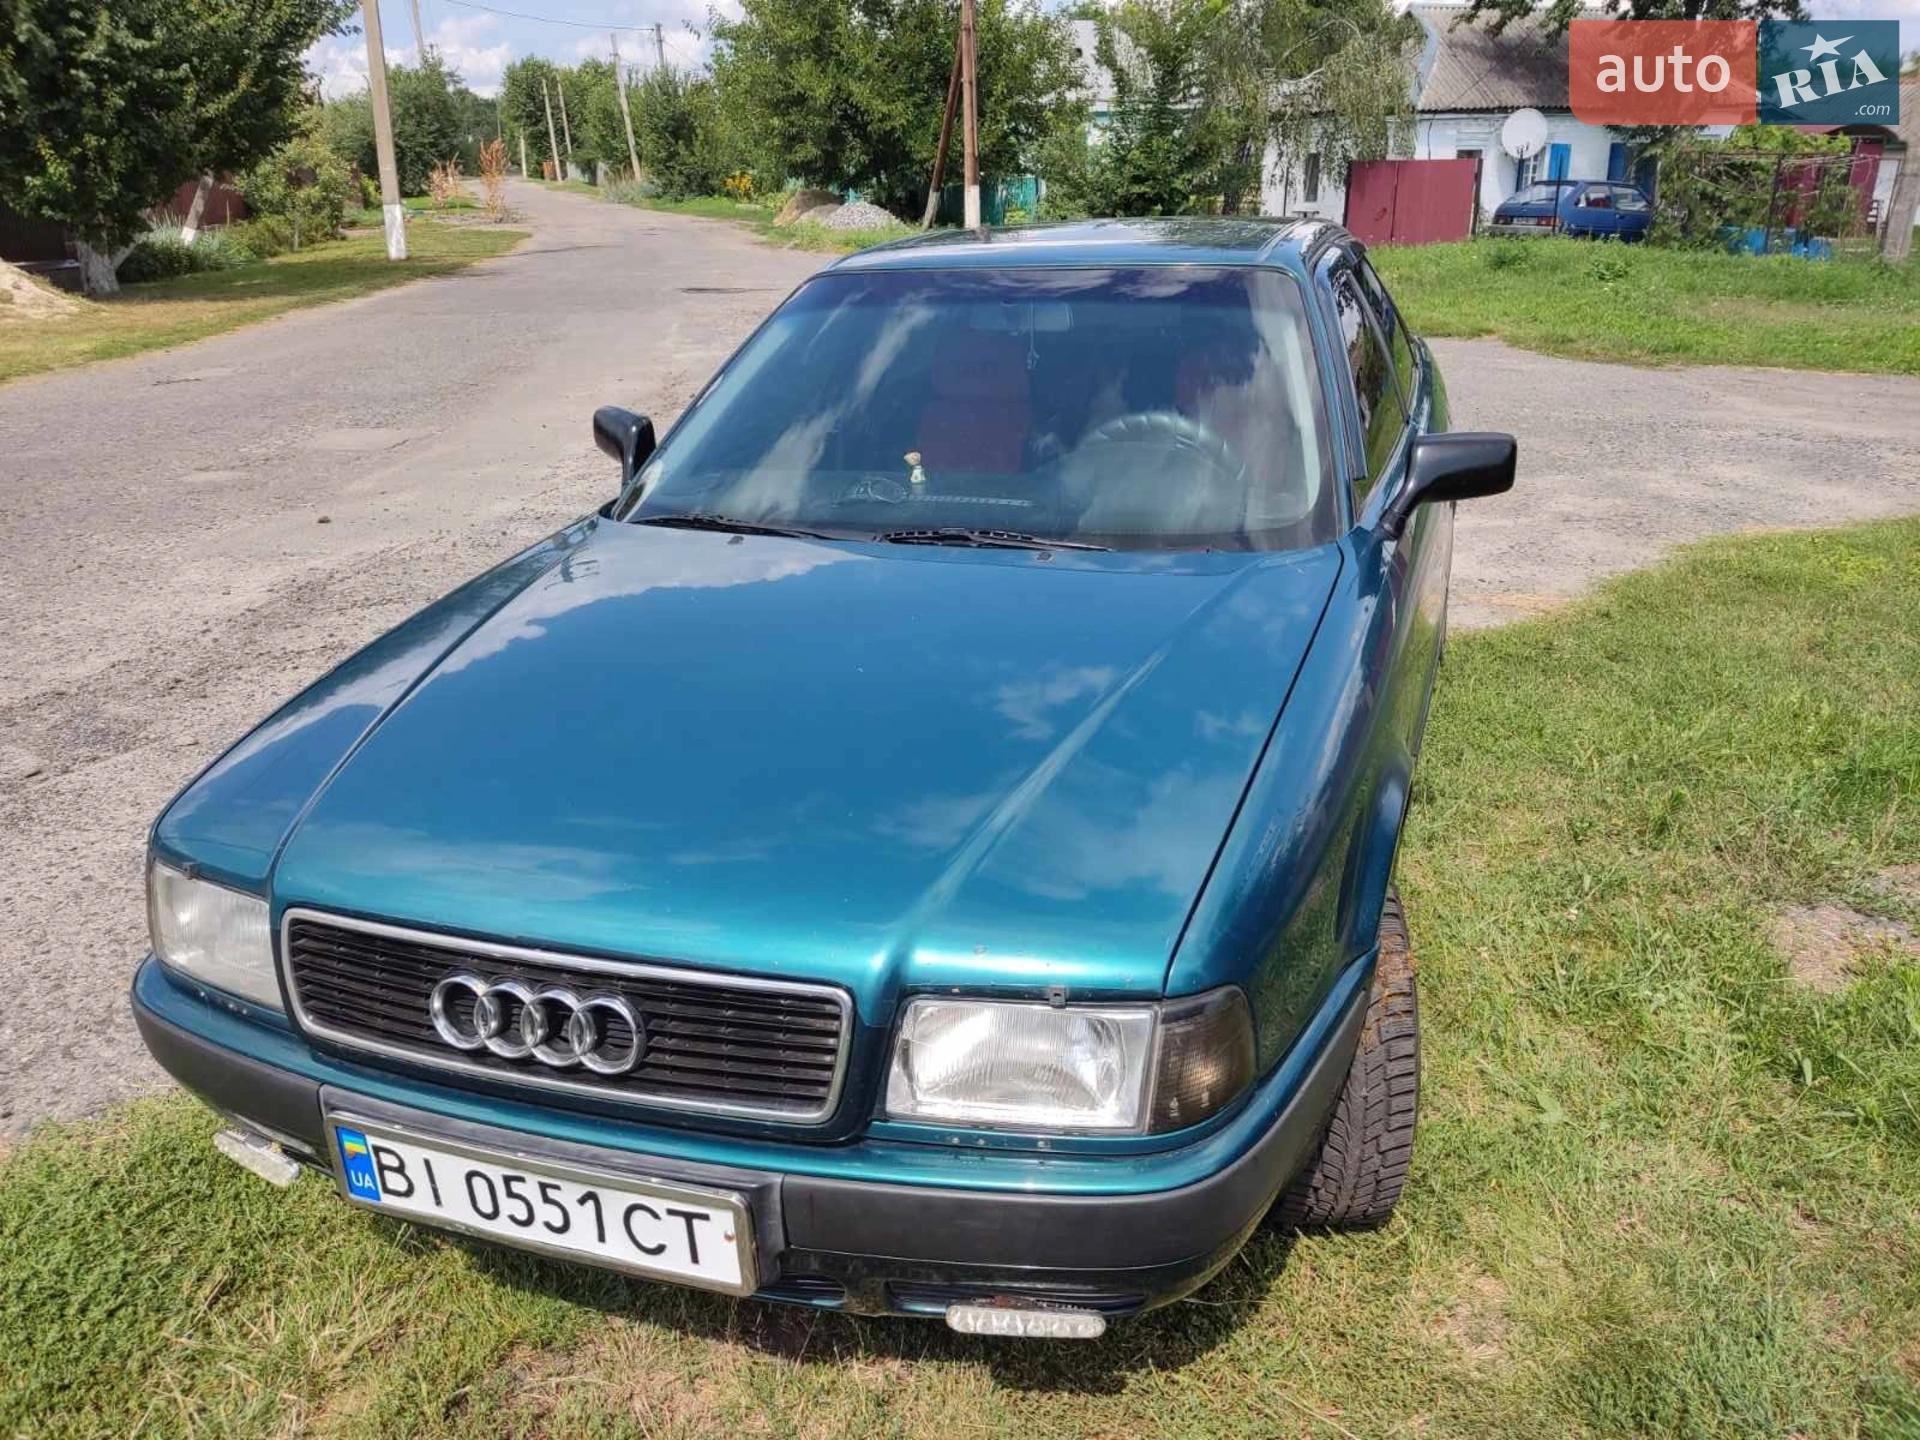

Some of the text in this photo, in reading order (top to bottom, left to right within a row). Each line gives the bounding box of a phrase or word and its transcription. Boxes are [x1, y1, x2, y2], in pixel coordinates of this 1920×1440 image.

[351, 1170, 376, 1191] UA
[372, 1144, 710, 1265] BI 0551 CT
